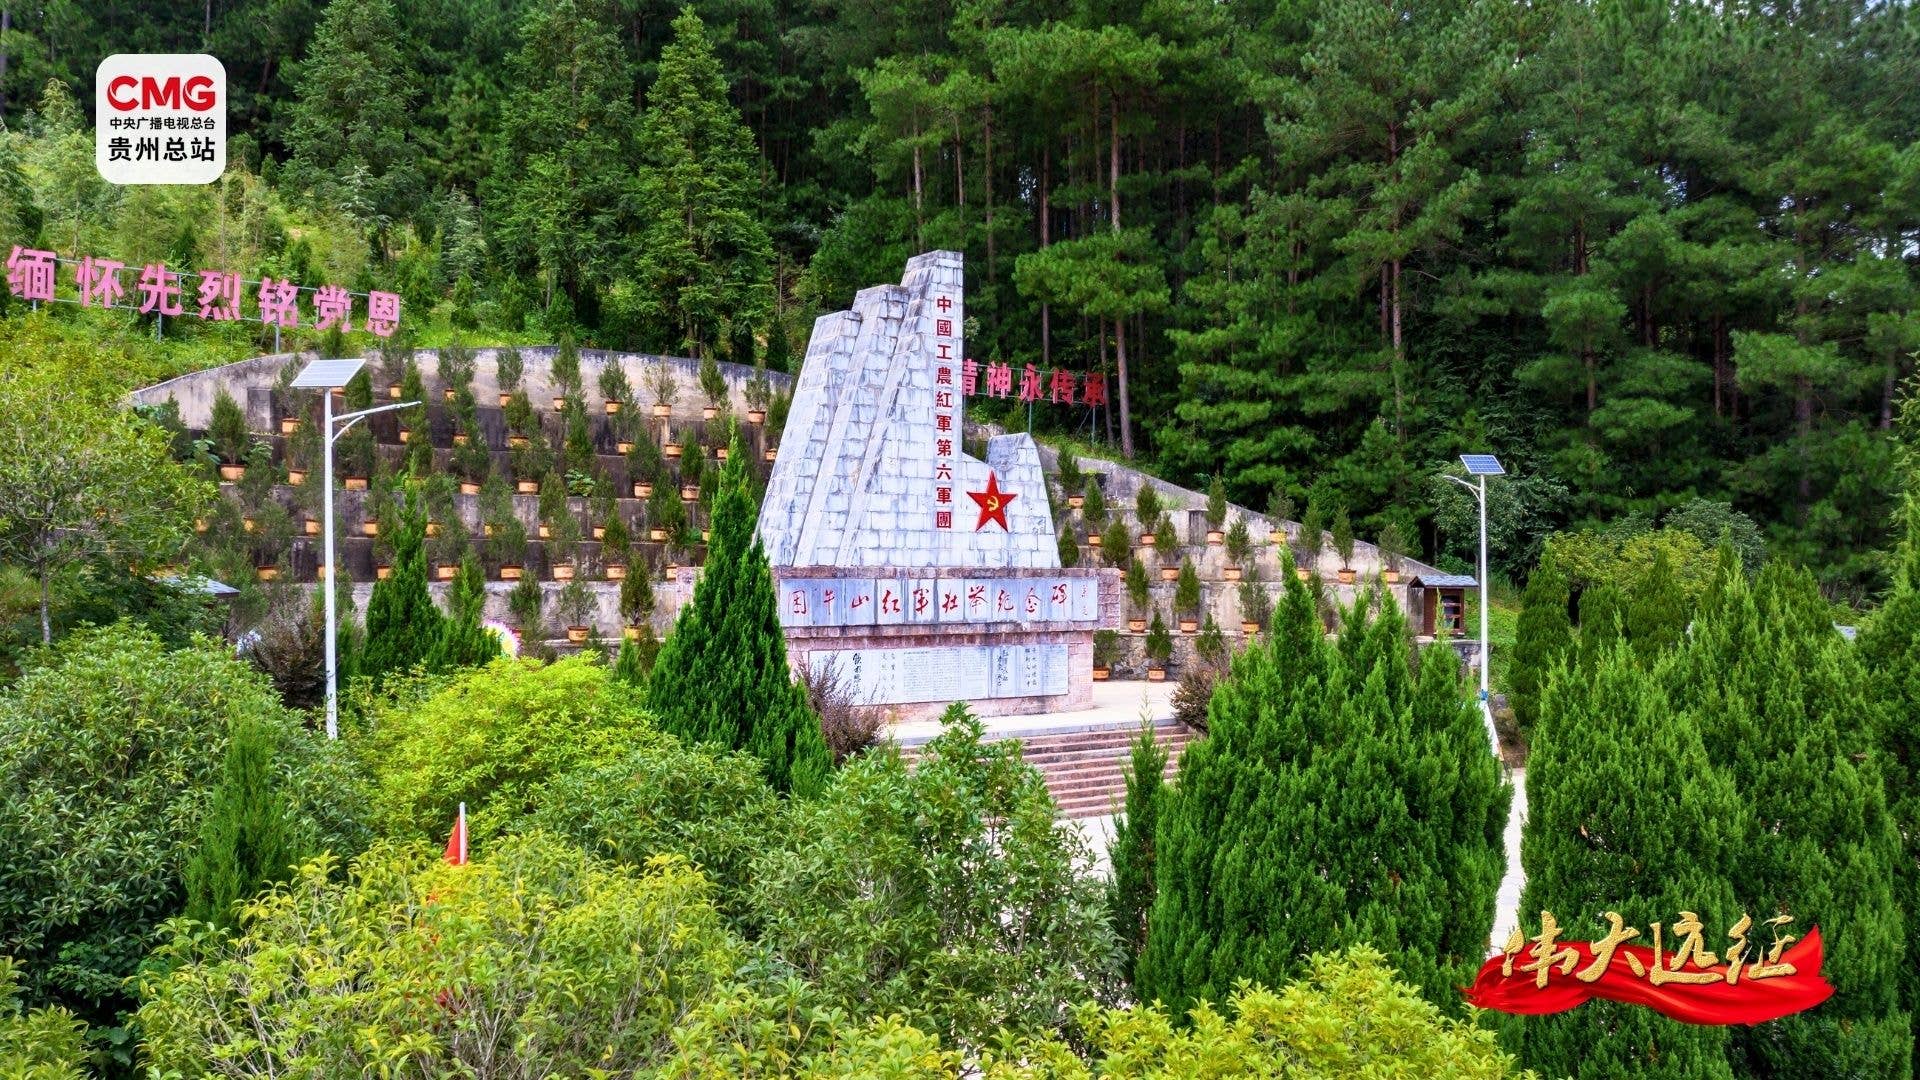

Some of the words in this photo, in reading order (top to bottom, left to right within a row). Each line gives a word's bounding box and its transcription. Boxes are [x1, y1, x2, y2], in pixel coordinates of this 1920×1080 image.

[6, 244, 401, 338] 缅怀先烈铭党恩
[936, 295, 953, 529] 中國工農紅軍第六軍團
